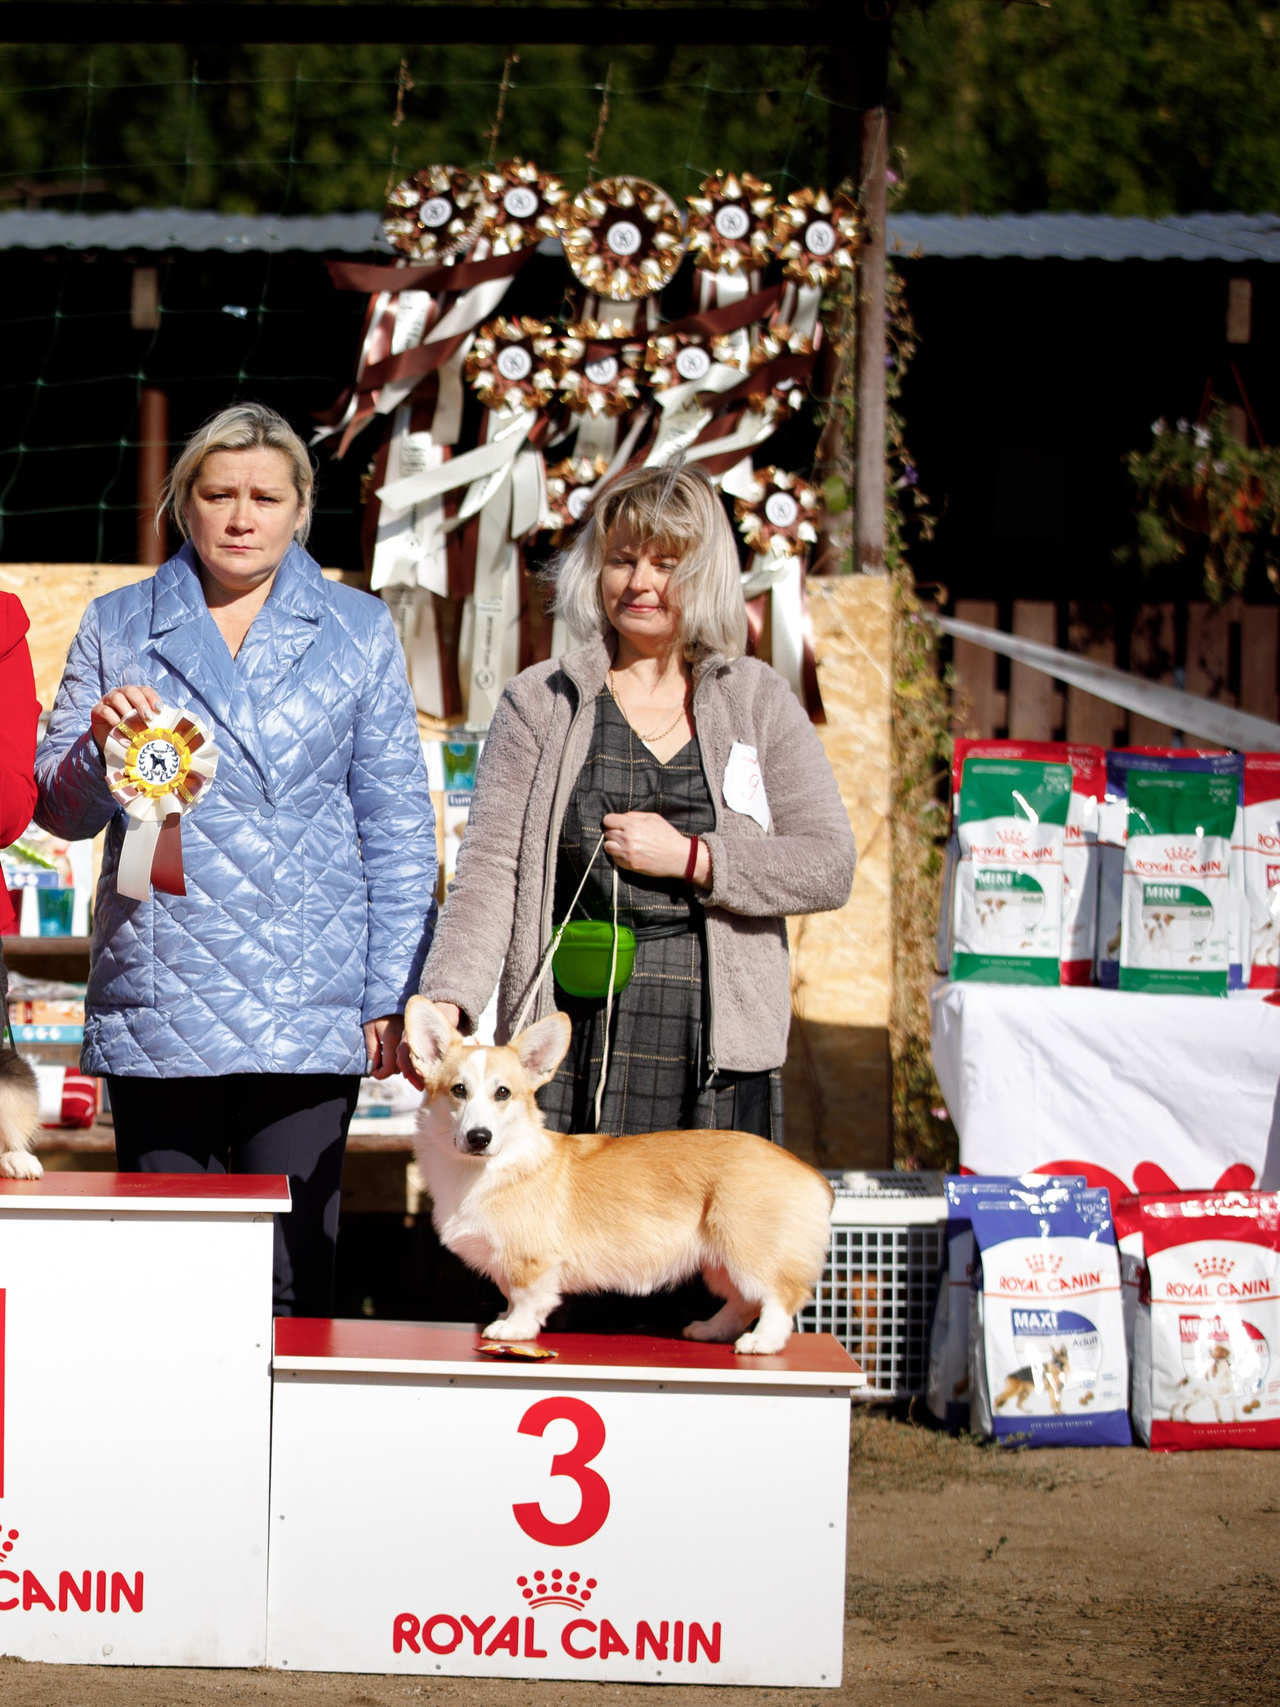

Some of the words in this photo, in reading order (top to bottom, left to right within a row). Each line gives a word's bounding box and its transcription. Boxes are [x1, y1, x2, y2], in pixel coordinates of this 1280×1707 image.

[971, 845, 1006, 859] ROYAL
[1012, 847, 1053, 860] CANIN
[1136, 859, 1175, 874] ROYAL
[1180, 861, 1221, 874] CANIN
[977, 871, 1013, 885] MINI
[1145, 886, 1180, 900] MINI
[999, 1276, 1042, 1292] ROYAL
[1047, 1272, 1101, 1292] CANIN
[1166, 1282, 1212, 1297] ROYAL
[1217, 1278, 1270, 1297] CANIN
[1013, 1311, 1058, 1329] MAXI
[512, 1396, 610, 1546] 3
[393, 1613, 547, 1658] ROYAL
[561, 1619, 721, 1663] CANIN
